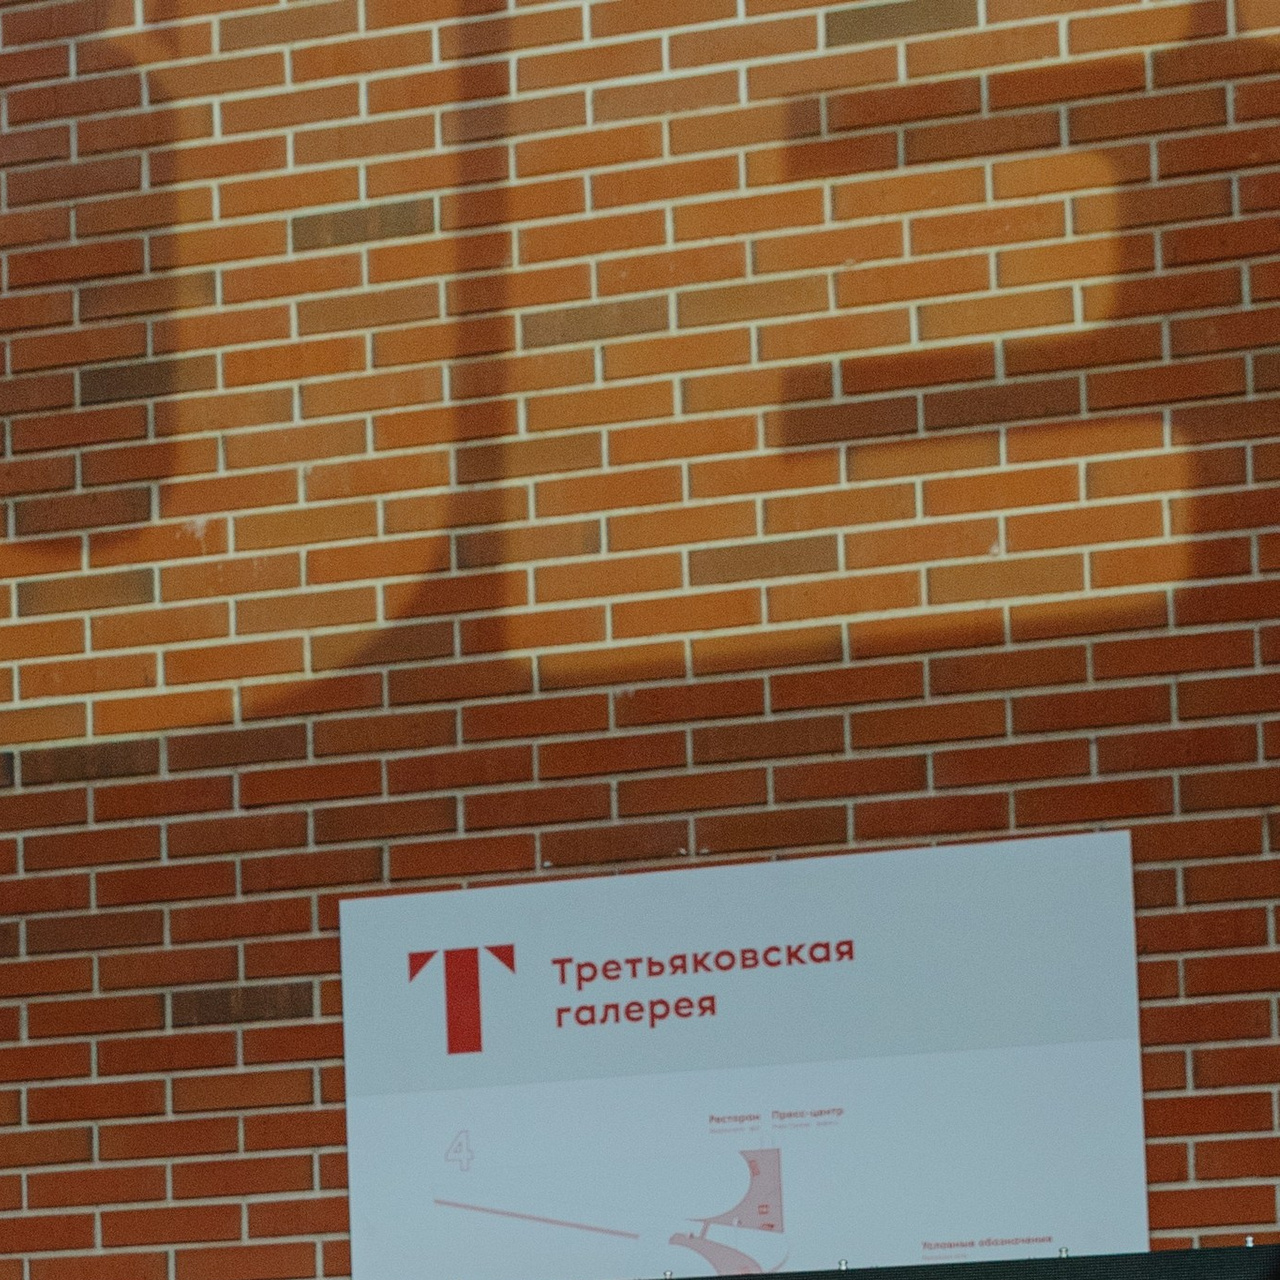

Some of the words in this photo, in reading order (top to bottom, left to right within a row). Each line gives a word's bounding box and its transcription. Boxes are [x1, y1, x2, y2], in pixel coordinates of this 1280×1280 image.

[551, 939, 856, 991] Третьяковская
[556, 994, 718, 1029] галерея
[443, 1129, 476, 1173] 4
